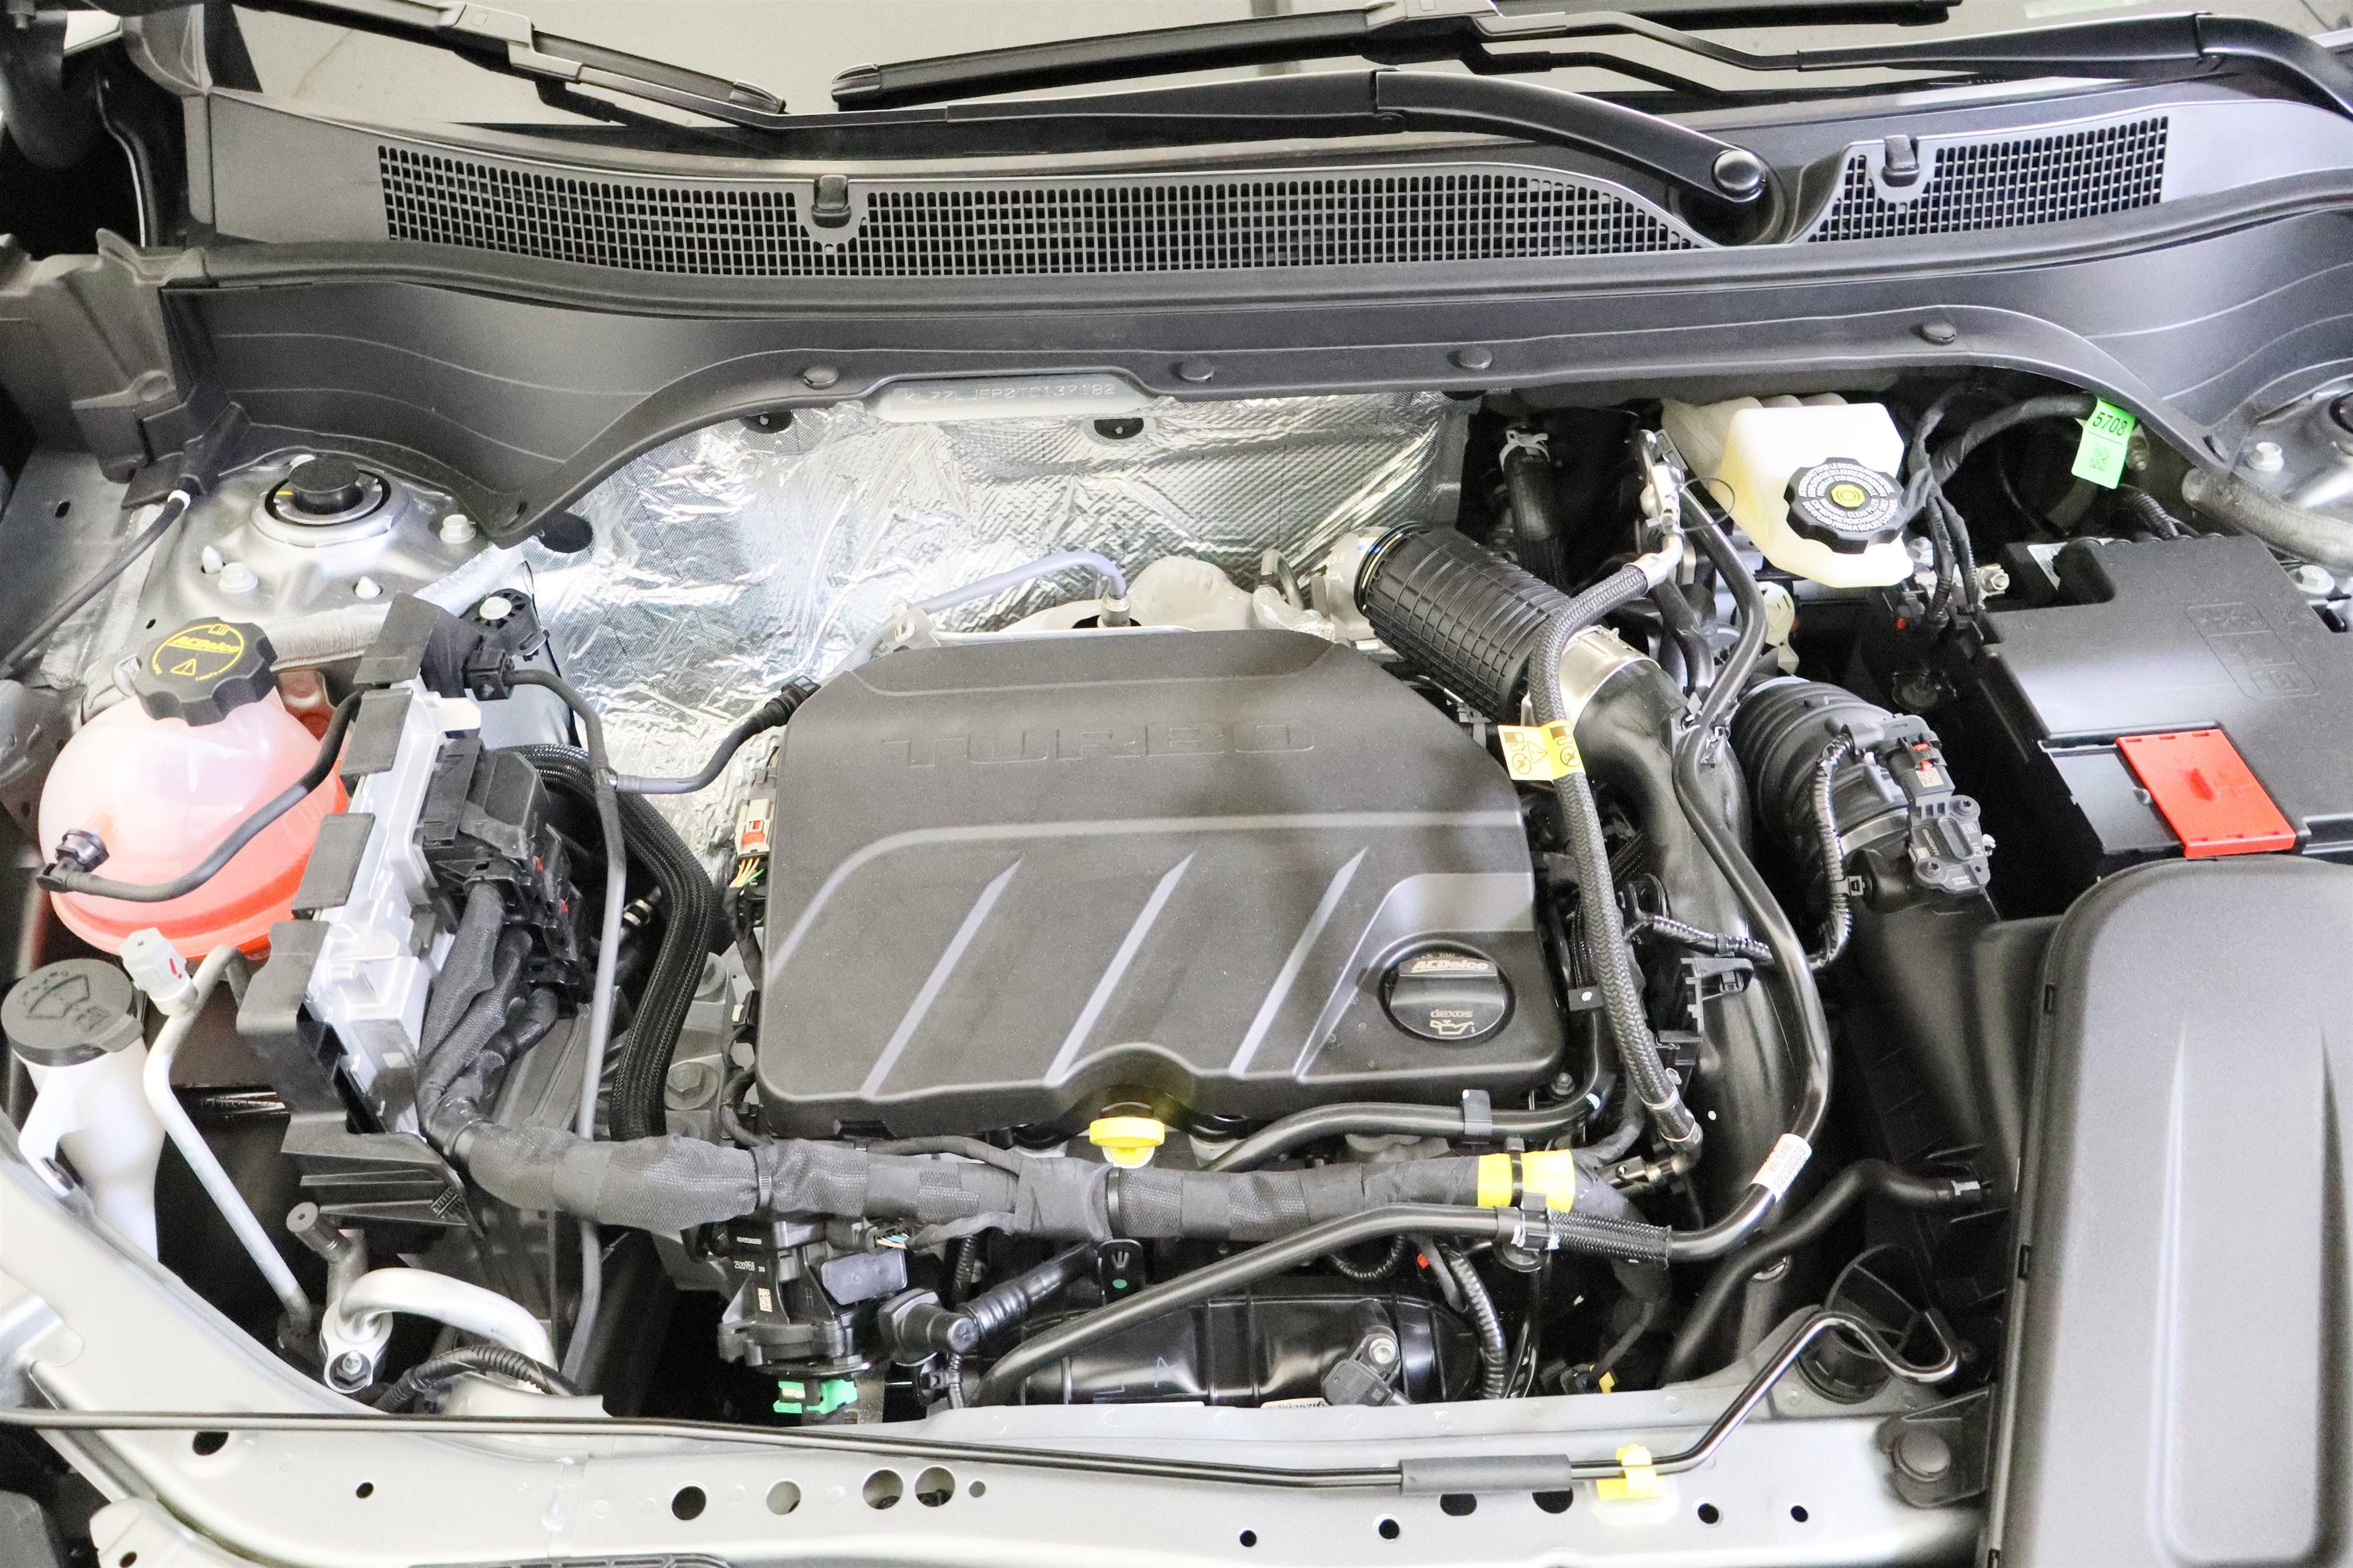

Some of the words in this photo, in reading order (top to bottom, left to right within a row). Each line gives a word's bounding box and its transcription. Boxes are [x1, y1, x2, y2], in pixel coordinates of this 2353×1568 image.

[2093, 412, 2128, 436] 5708
[1810, 500, 1823, 509] CAP
[1818, 508, 1843, 523] BEFORE
[1877, 499, 1888, 511] ONLY
[1847, 509, 1869, 518] CLEAN
[1865, 499, 1879, 513] FILLER
[1812, 512, 1833, 526] FLUID
[1831, 521, 1852, 531] FROM
[1857, 520, 1883, 531] SEALED
[171, 636, 241, 654] ACDelco
[882, 724, 1316, 768] TURBO
[1411, 960, 1489, 971] ACDelco
[1430, 1009, 1473, 1018] dexos
